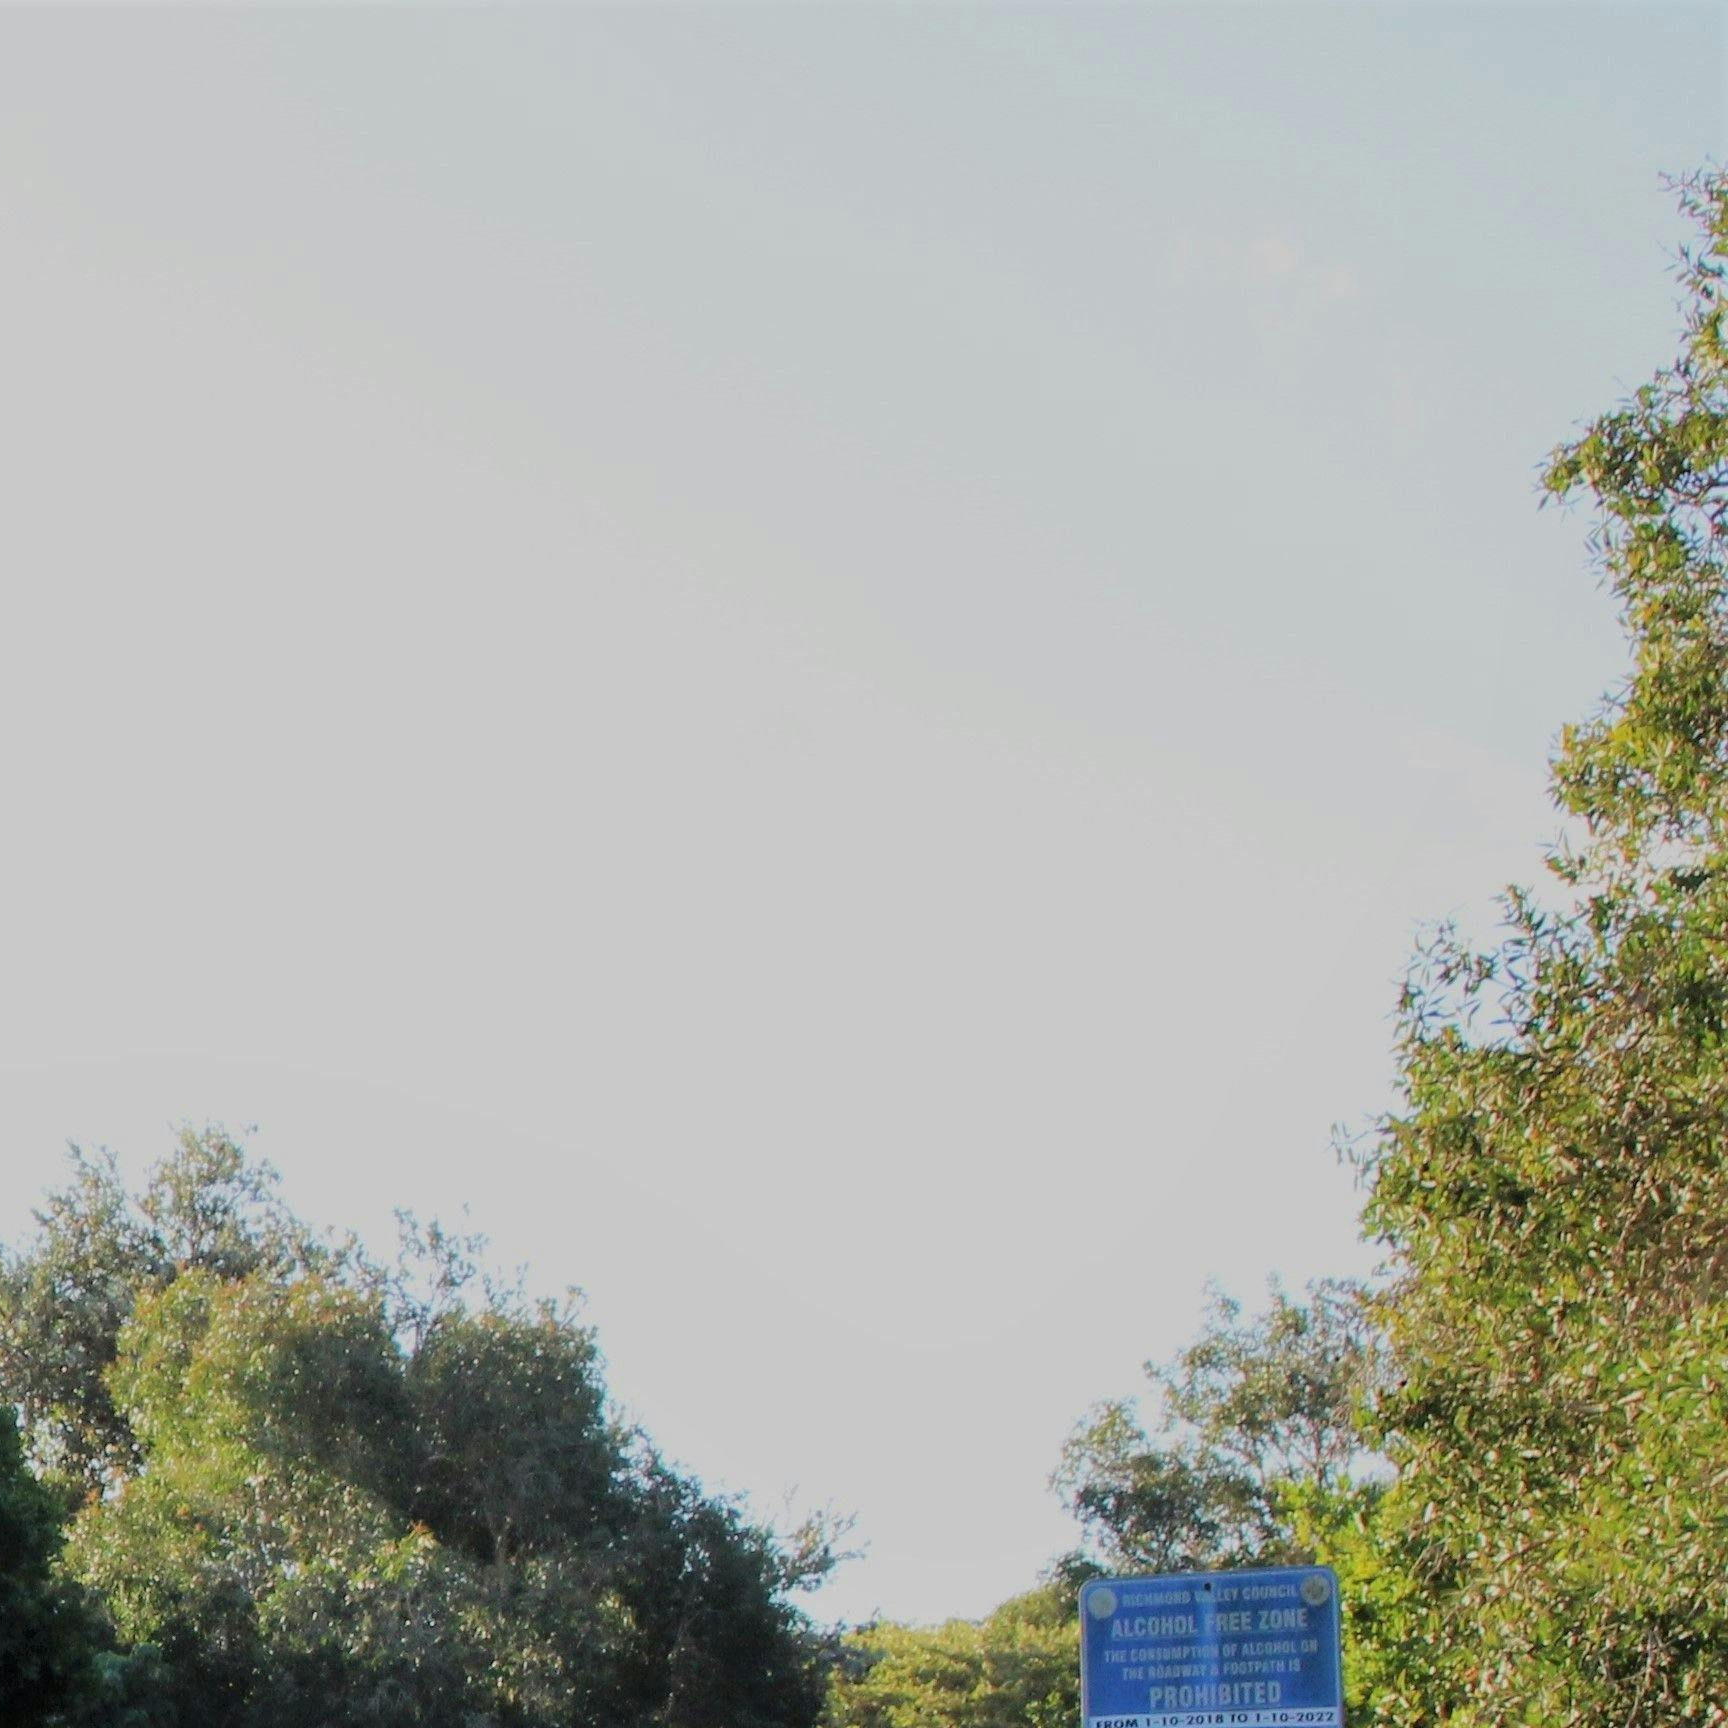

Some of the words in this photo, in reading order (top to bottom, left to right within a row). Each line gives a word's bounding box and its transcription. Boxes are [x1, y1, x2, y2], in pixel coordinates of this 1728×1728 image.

[1242, 1584, 1298, 1600] COUNCIL
[1112, 1614, 1198, 1637] ALCOHOL
[1204, 1611, 1252, 1633] FREE
[1259, 1608, 1309, 1630] ZONE
[1104, 1650, 1127, 1663] THE
[1131, 1644, 1219, 1662] CONSUMPTION
[1223, 1644, 1237, 1657] OF
[1242, 1641, 1297, 1656] ALCOHOL
[1301, 1640, 1318, 1652] ON
[1123, 1667, 1144, 1680] THE
[1148, 1663, 1207, 1678] ROADWAY
[1223, 1659, 1284, 1675] FOOTPATH
[1289, 1658, 1301, 1672] IS
[1149, 1681, 1282, 1709] PROHIBITED
[1146, 1713, 1224, 1727] 1-10-2018
[1230, 1713, 1248, 1723] TO
[1255, 1711, 1335, 1724] 1-10-2022
